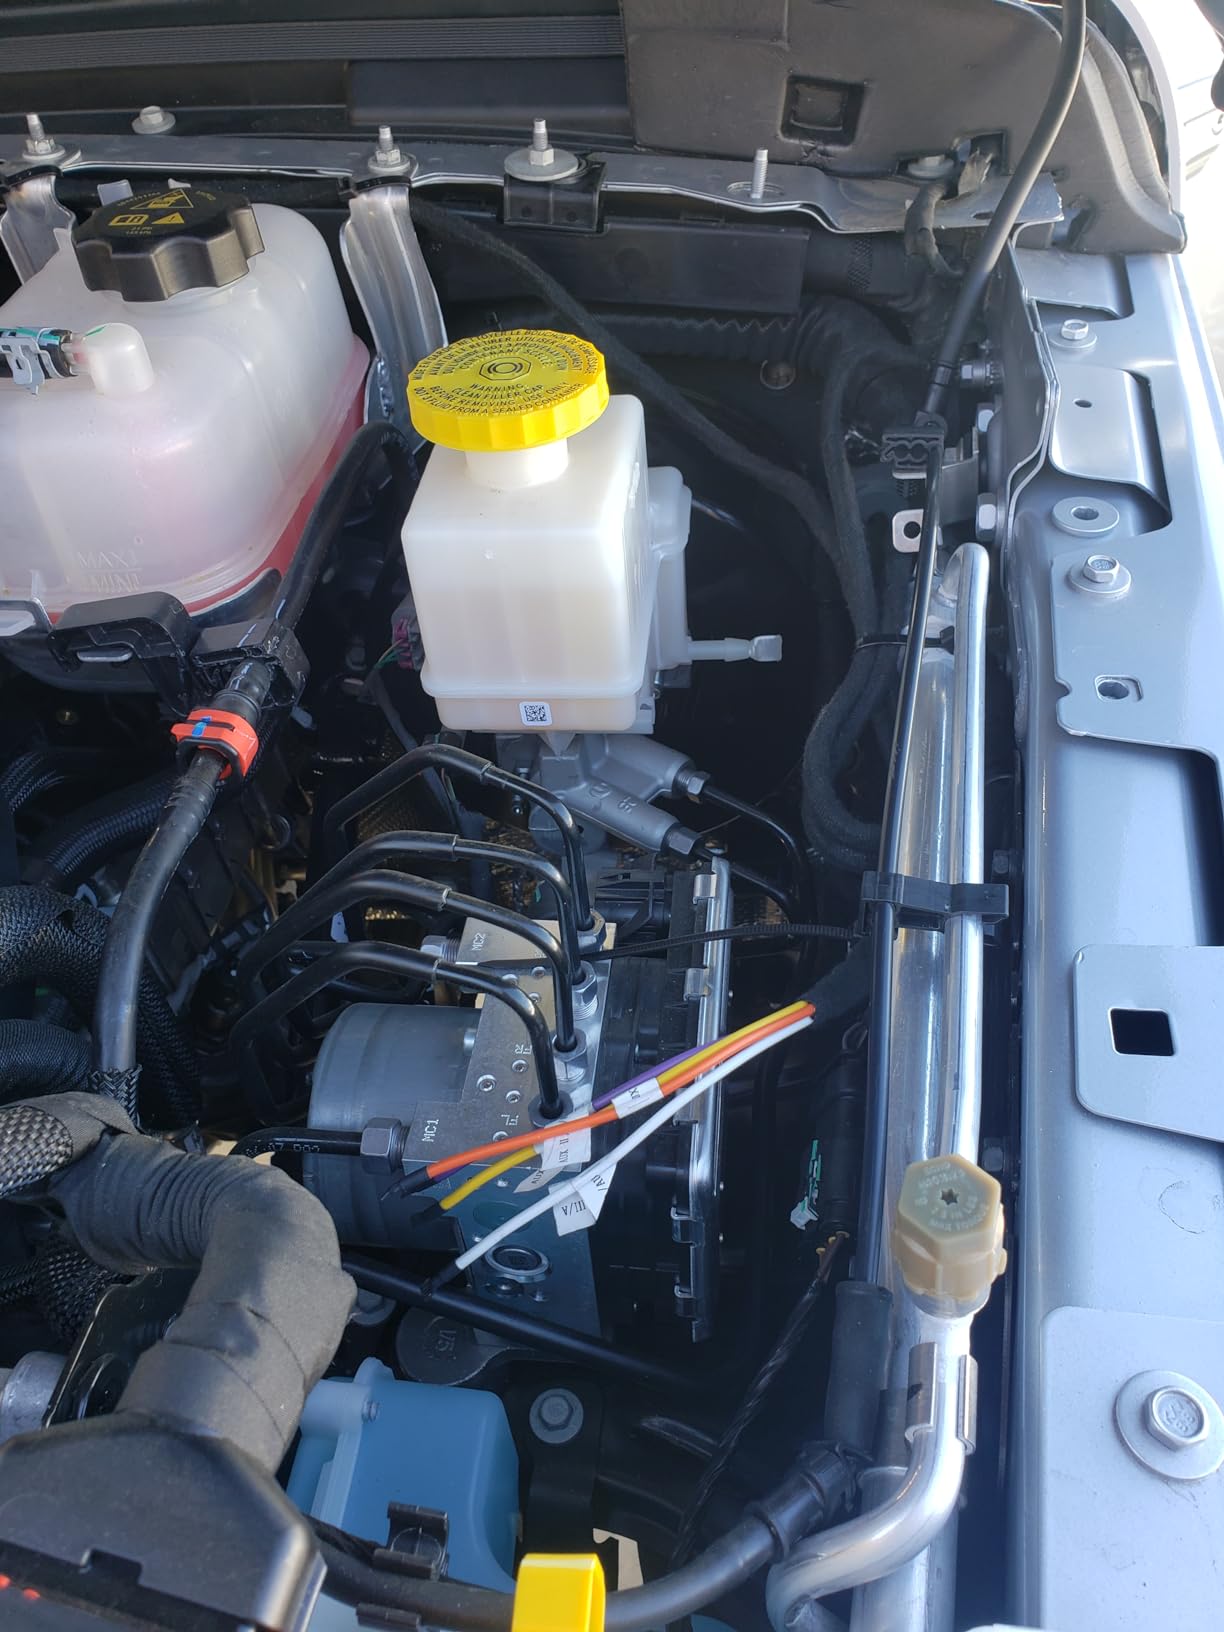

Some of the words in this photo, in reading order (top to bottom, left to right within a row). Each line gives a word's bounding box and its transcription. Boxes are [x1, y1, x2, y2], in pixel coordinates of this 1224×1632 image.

[468, 337, 511, 349] RETIRER
[482, 343, 504, 352] DOT
[429, 385, 458, 402] BEFORE
[523, 393, 544, 403] USE
[545, 381, 570, 395] ONLY
[451, 387, 482, 399] CLEAN
[483, 391, 521, 400] FILLER
[524, 384, 543, 395] CAP
[451, 405, 480, 415] FROM
[492, 404, 533, 414] SEALED
[471, 932, 487, 951] MC2
[421, 1119, 440, 1143] MC1
[559, 1148, 569, 1163] AUX
[531, 1169, 545, 1184] AUX
